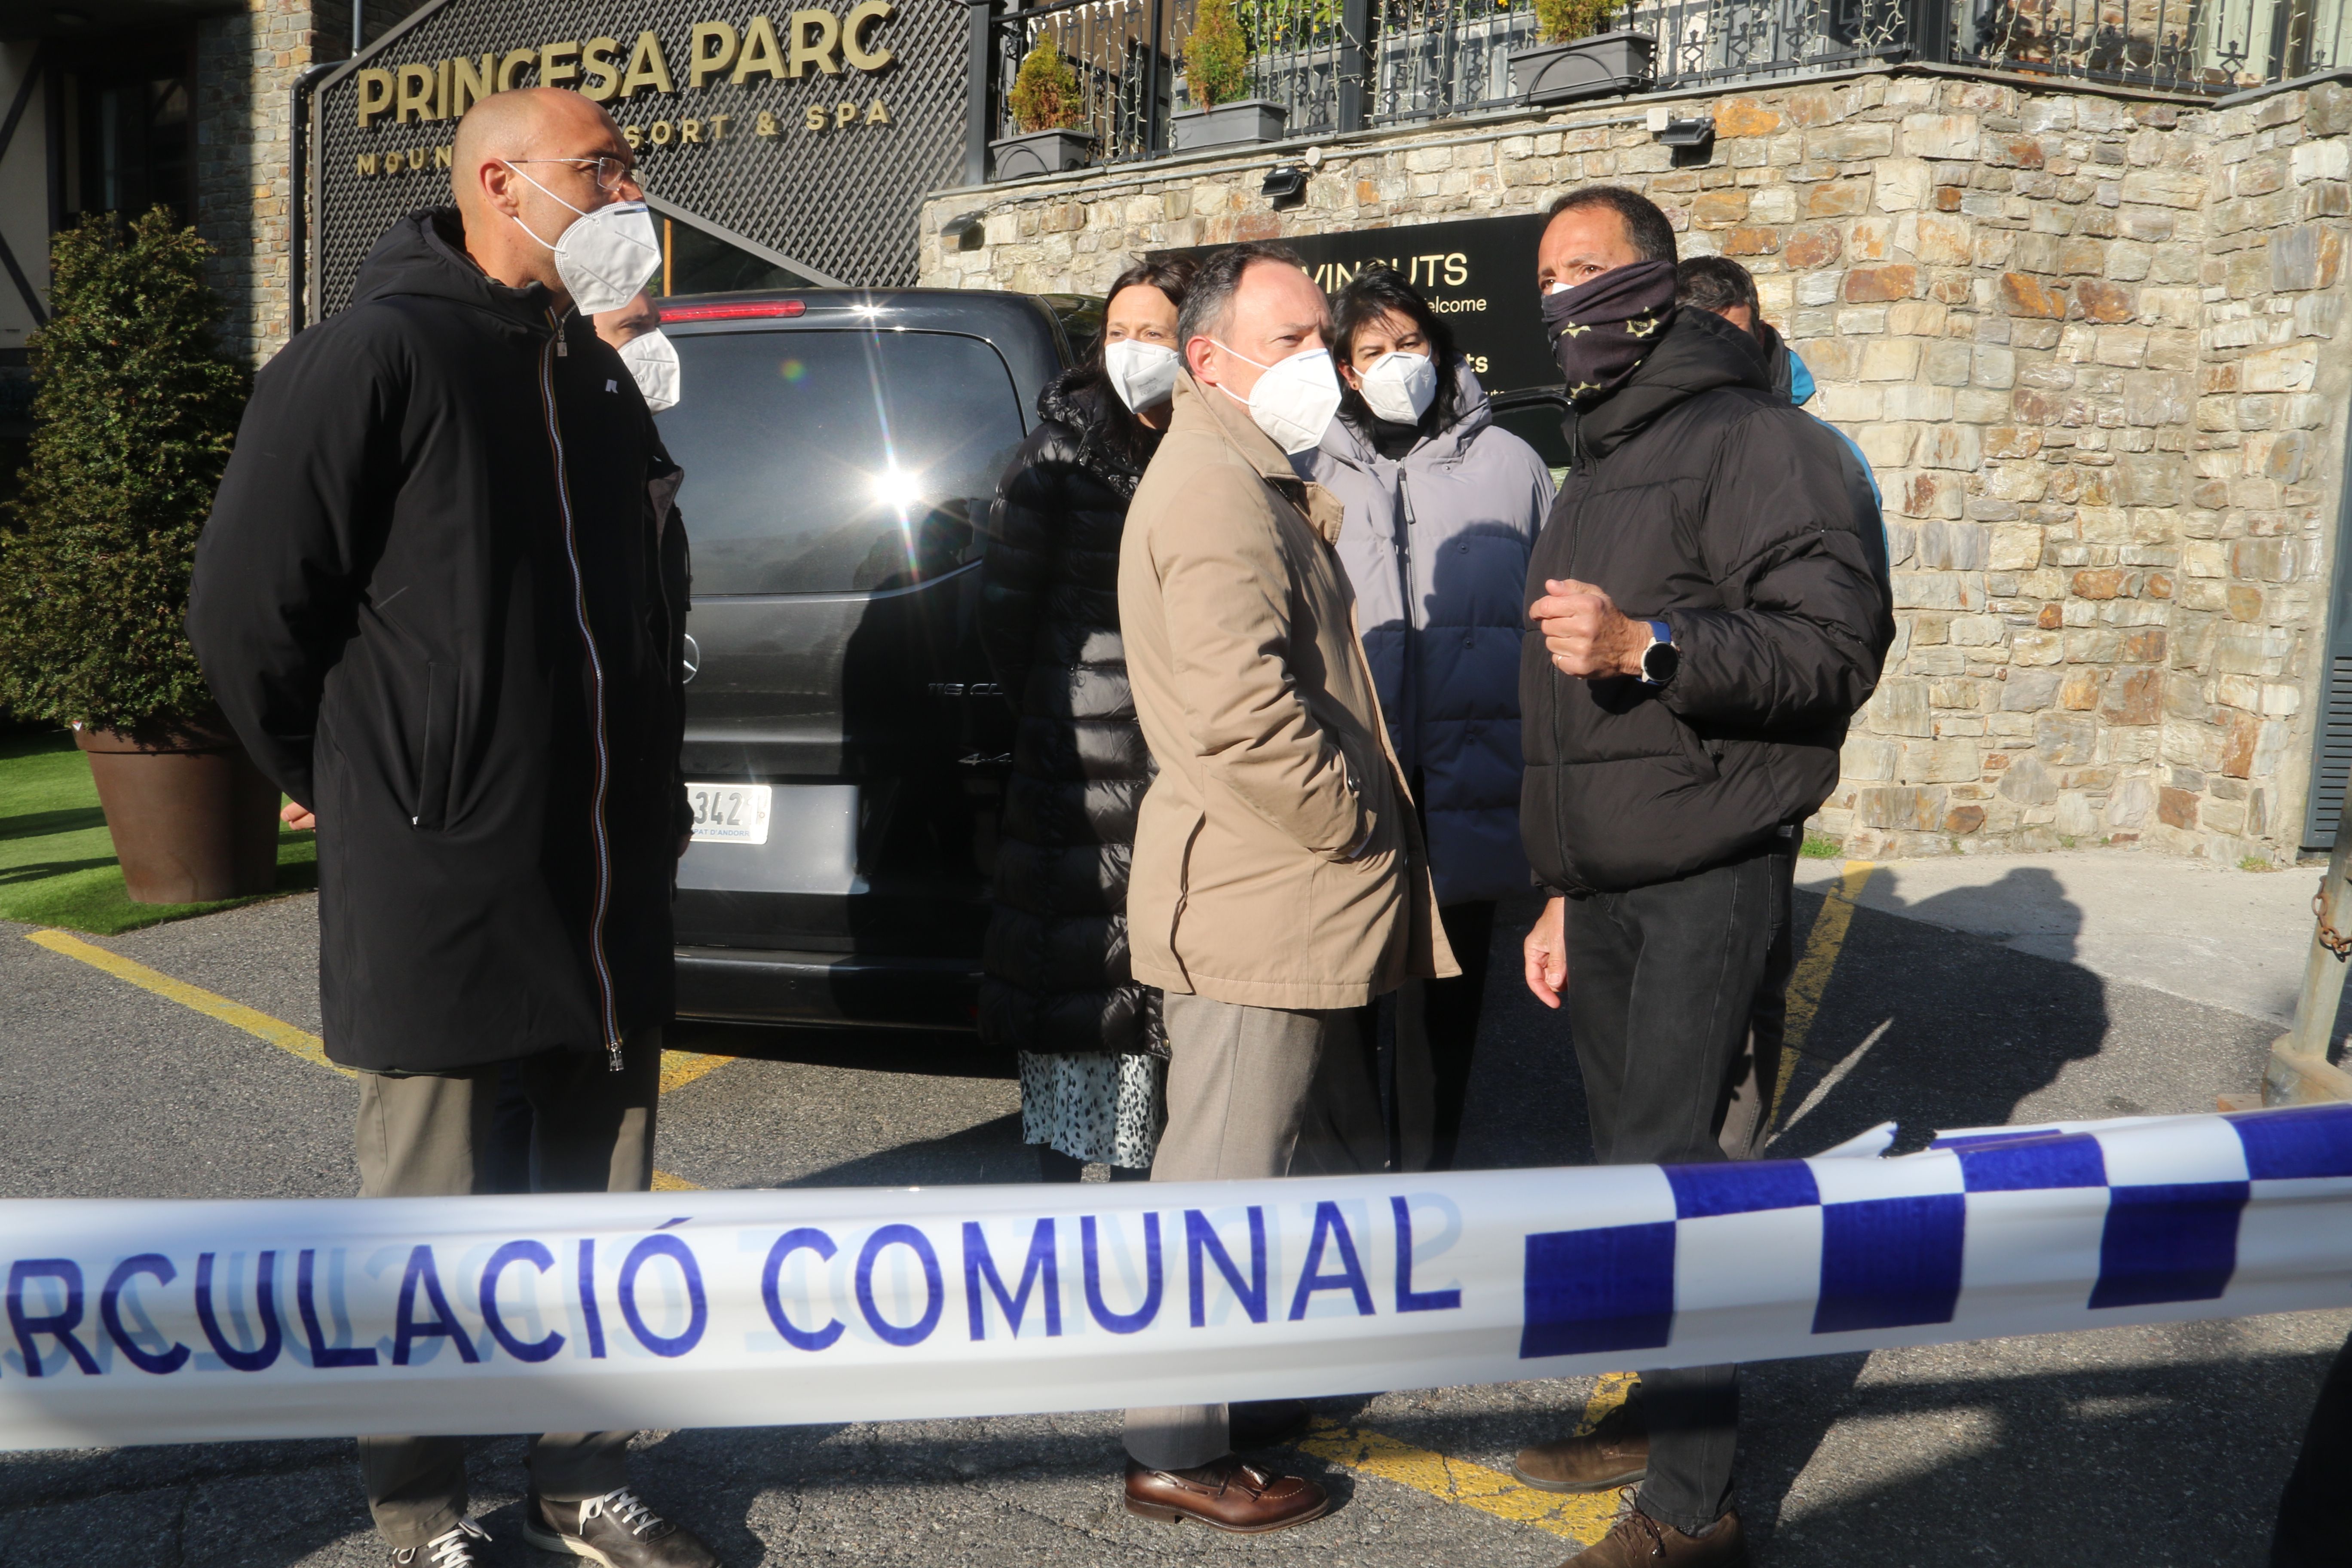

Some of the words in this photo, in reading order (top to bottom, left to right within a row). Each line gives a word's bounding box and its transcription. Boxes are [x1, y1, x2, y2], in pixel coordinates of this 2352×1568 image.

[690, 0, 895, 87] PARC
[358, 145, 451, 175] MOUN
[624, 113, 729, 149] SORT
[757, 112, 780, 136] &
[806, 99, 893, 130] SPA
[1302, 252, 1468, 294] VINUTS
[1425, 296, 1486, 313] elcome
[694, 791, 759, 825] 3421
[3, 1217, 707, 1377] RCULACIÓ
[762, 1195, 1462, 1351] COMUNAL
